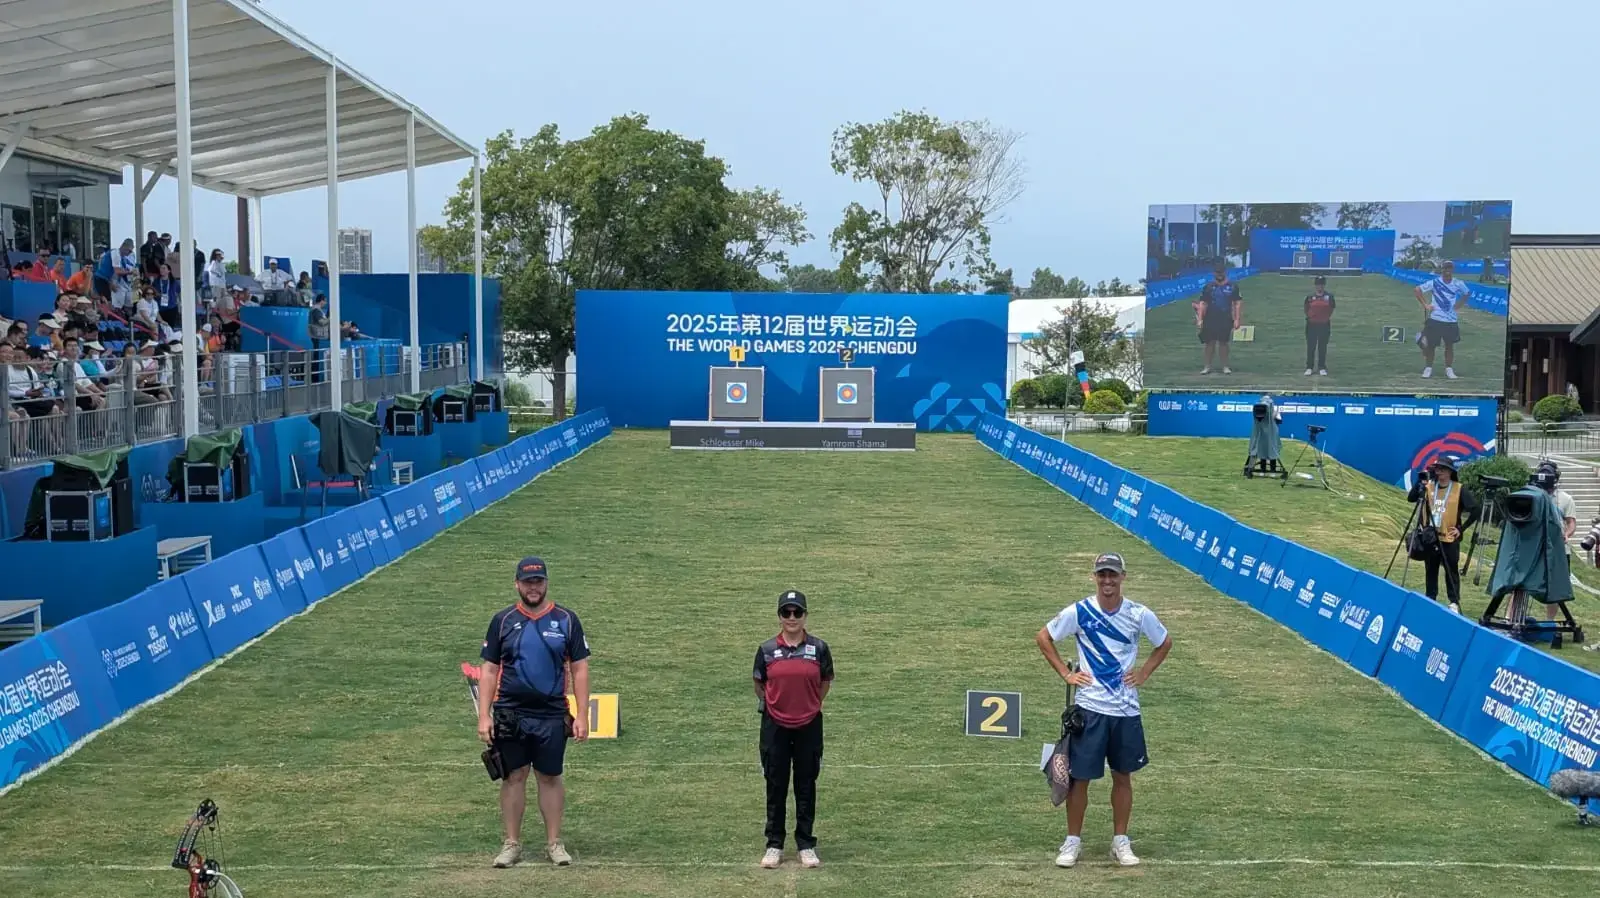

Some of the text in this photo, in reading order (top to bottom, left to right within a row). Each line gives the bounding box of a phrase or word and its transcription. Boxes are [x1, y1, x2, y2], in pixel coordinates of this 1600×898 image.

[667, 313, 918, 337] 2025年第12届世界运动会
[1389, 328, 1399, 340] 2
[667, 339, 695, 352] THE
[754, 340, 805, 353] GAMES
[808, 340, 846, 353] 2025
[849, 341, 917, 354] CHENGDU
[734, 348, 740, 359] 1
[842, 349, 852, 361] 2
[746, 438, 765, 447] Mike
[147, 635, 169, 657] TISSOT
[2, 716, 33, 745] GAMES
[28, 707, 51, 731] 2025
[47, 690, 80, 721] CHENGDU
[589, 699, 599, 732] 1
[981, 696, 1008, 732] 2
[1482, 695, 1598, 768] THE WORLD GAMES 2025 CHENGDU
